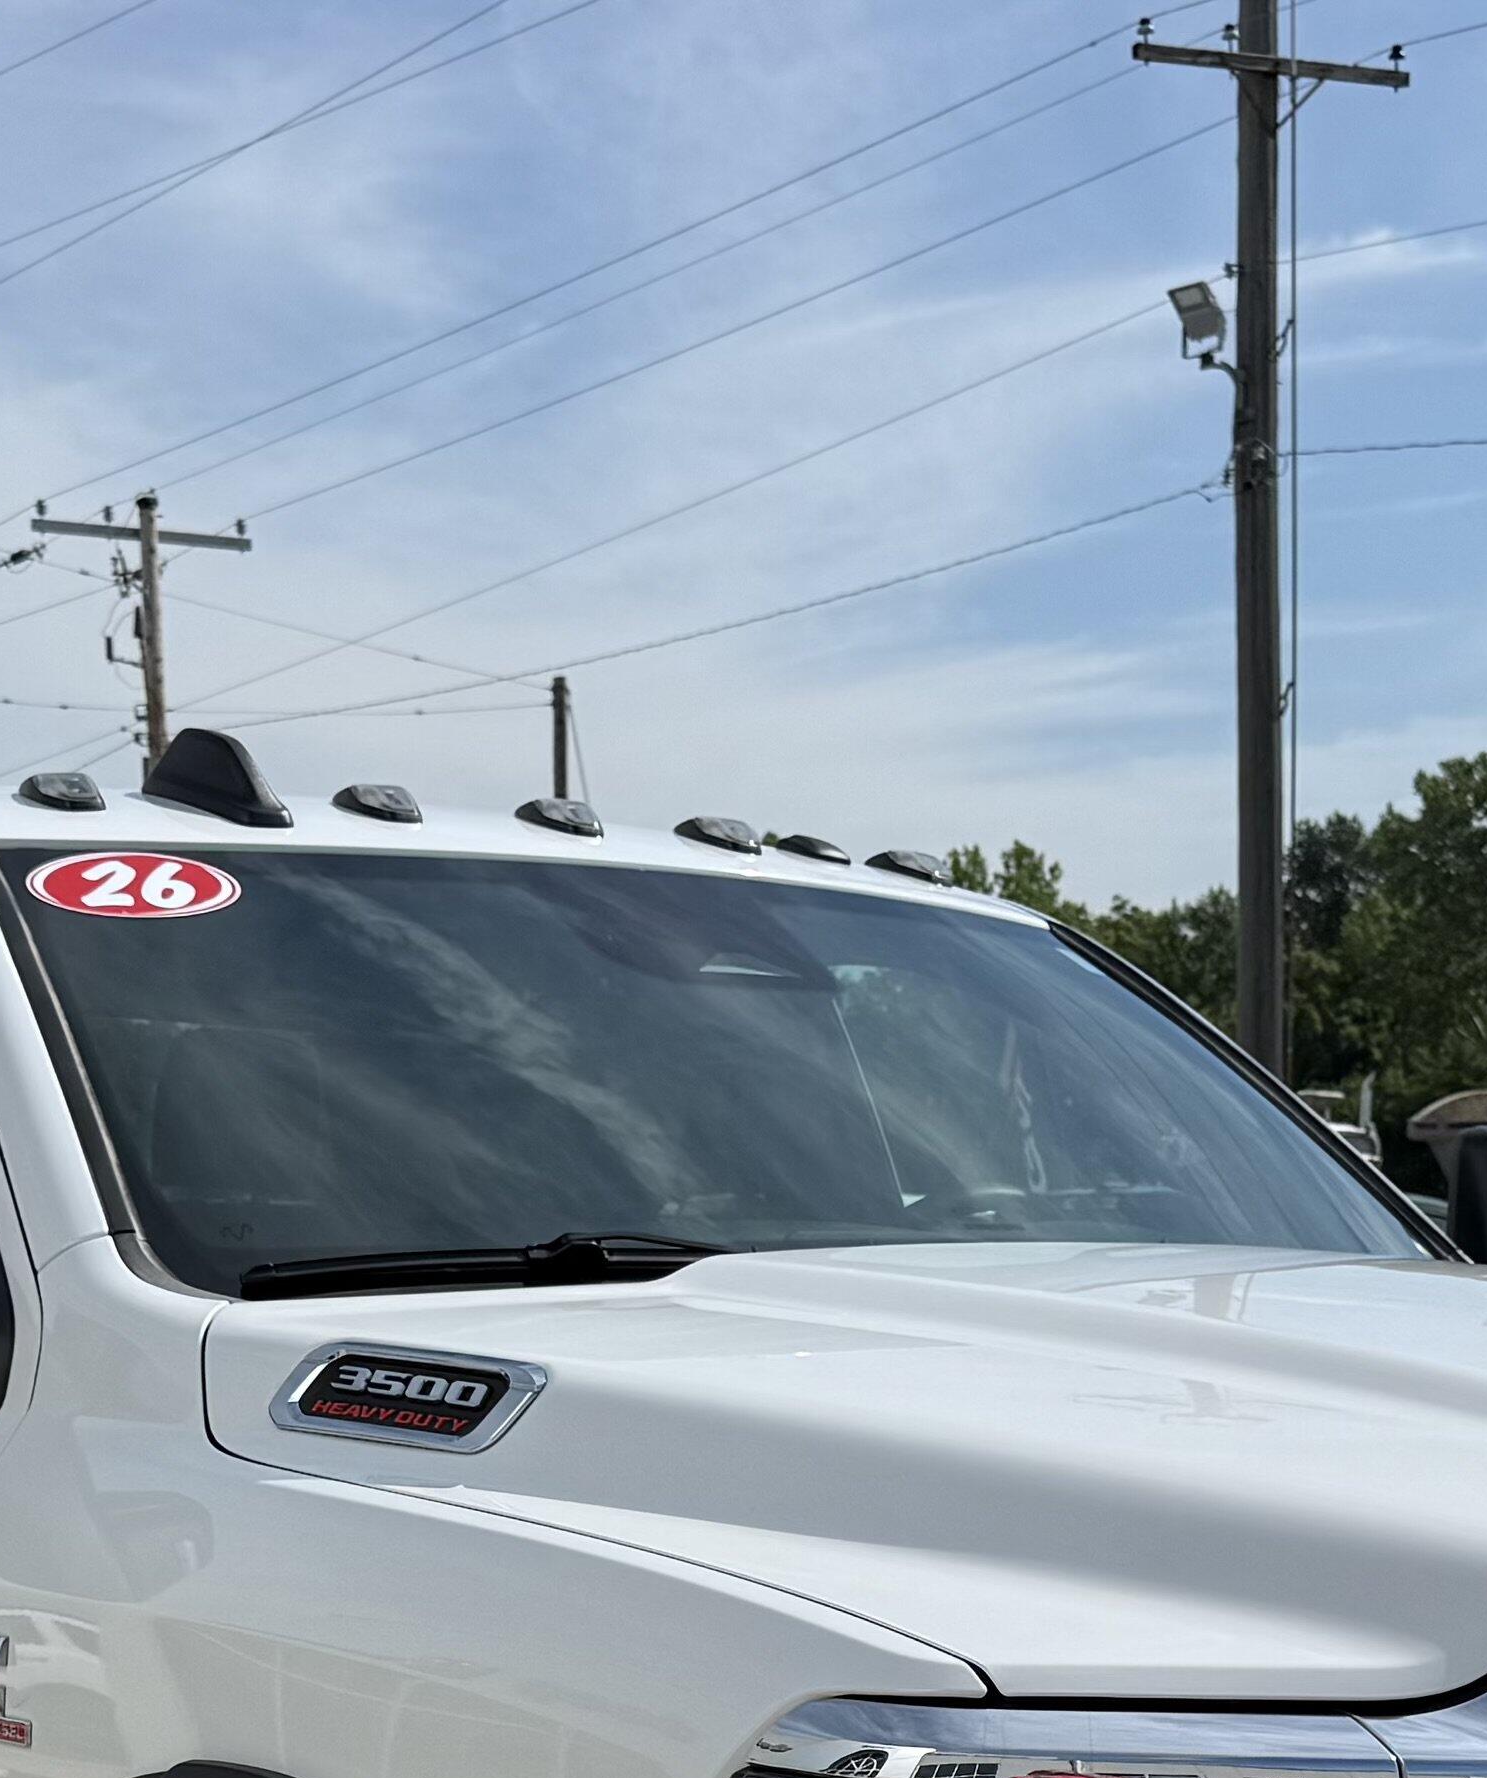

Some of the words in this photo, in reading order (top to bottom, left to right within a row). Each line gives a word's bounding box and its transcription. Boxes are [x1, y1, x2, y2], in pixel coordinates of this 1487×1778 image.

[80, 860, 197, 909] 26
[330, 1365, 489, 1408] 3500
[311, 1400, 394, 1421] HEAVY
[394, 1410, 470, 1433] DUTY
